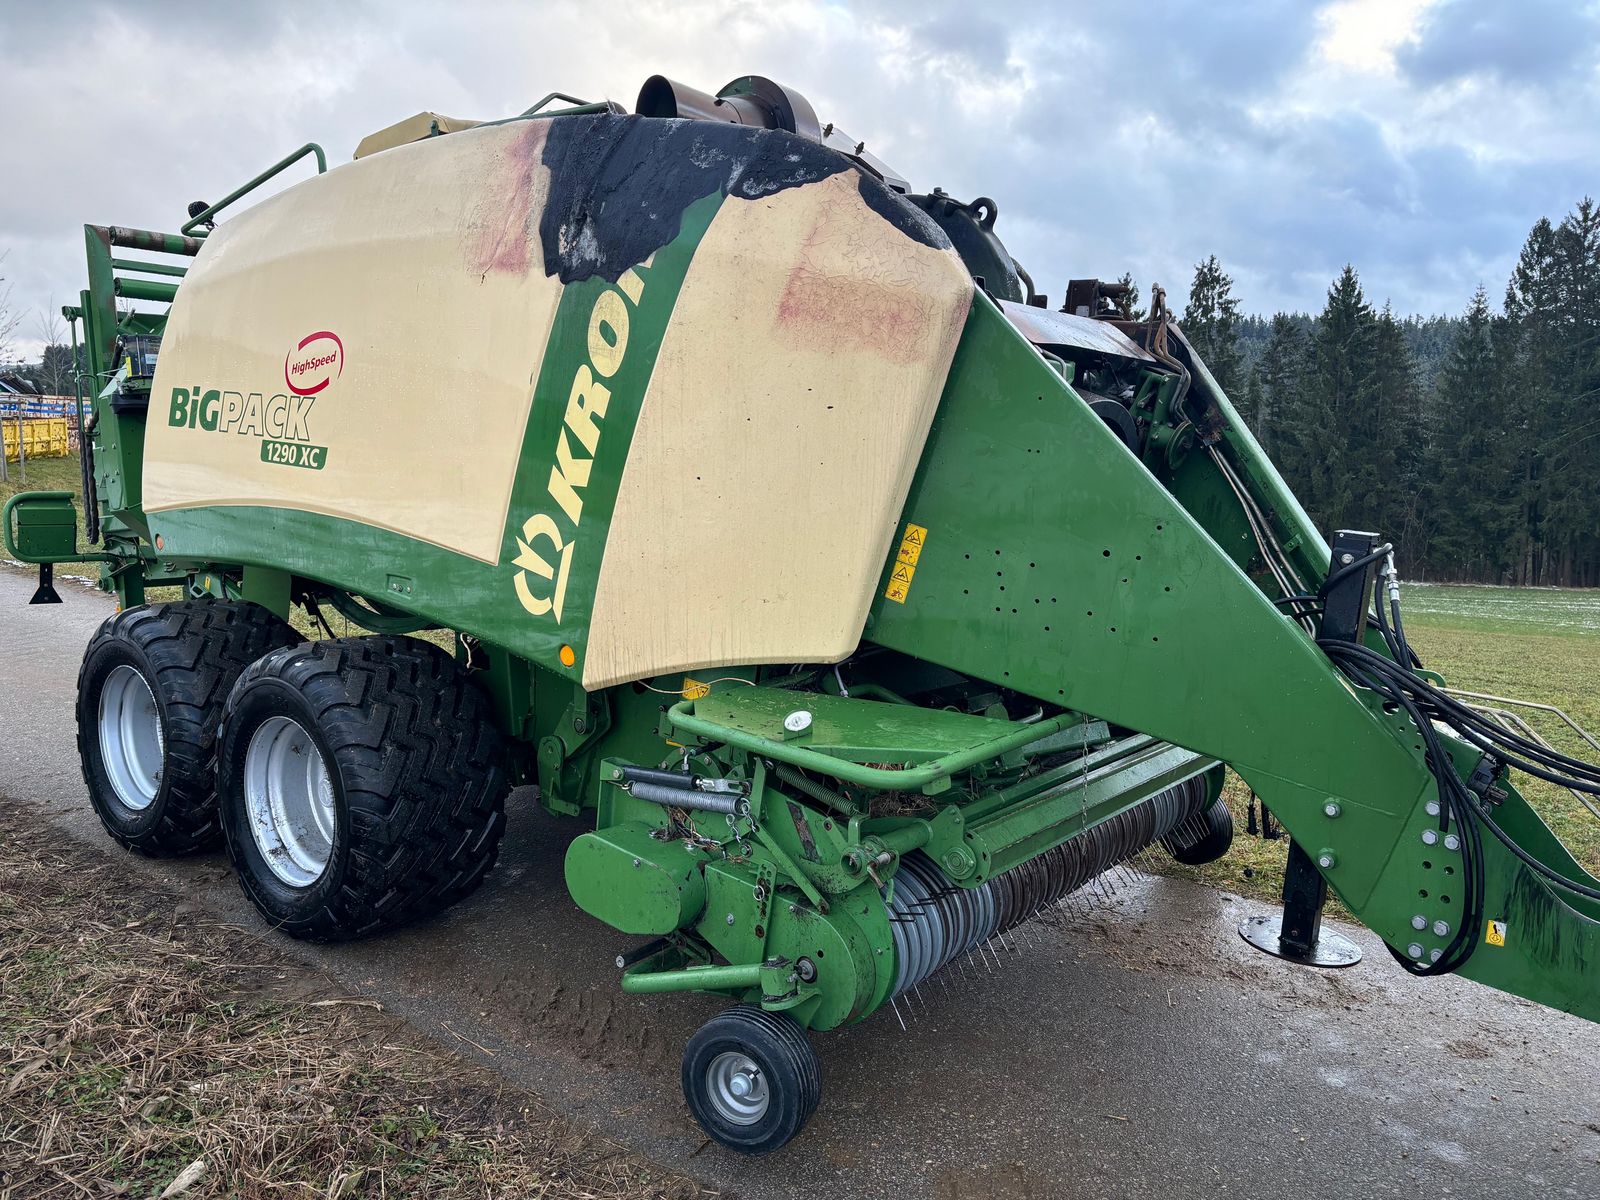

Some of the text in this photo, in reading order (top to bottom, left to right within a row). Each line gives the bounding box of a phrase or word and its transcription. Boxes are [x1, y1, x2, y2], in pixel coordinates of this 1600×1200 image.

[291, 350, 337, 375] HighSpeed
[267, 442, 320, 467] 1290 XC
